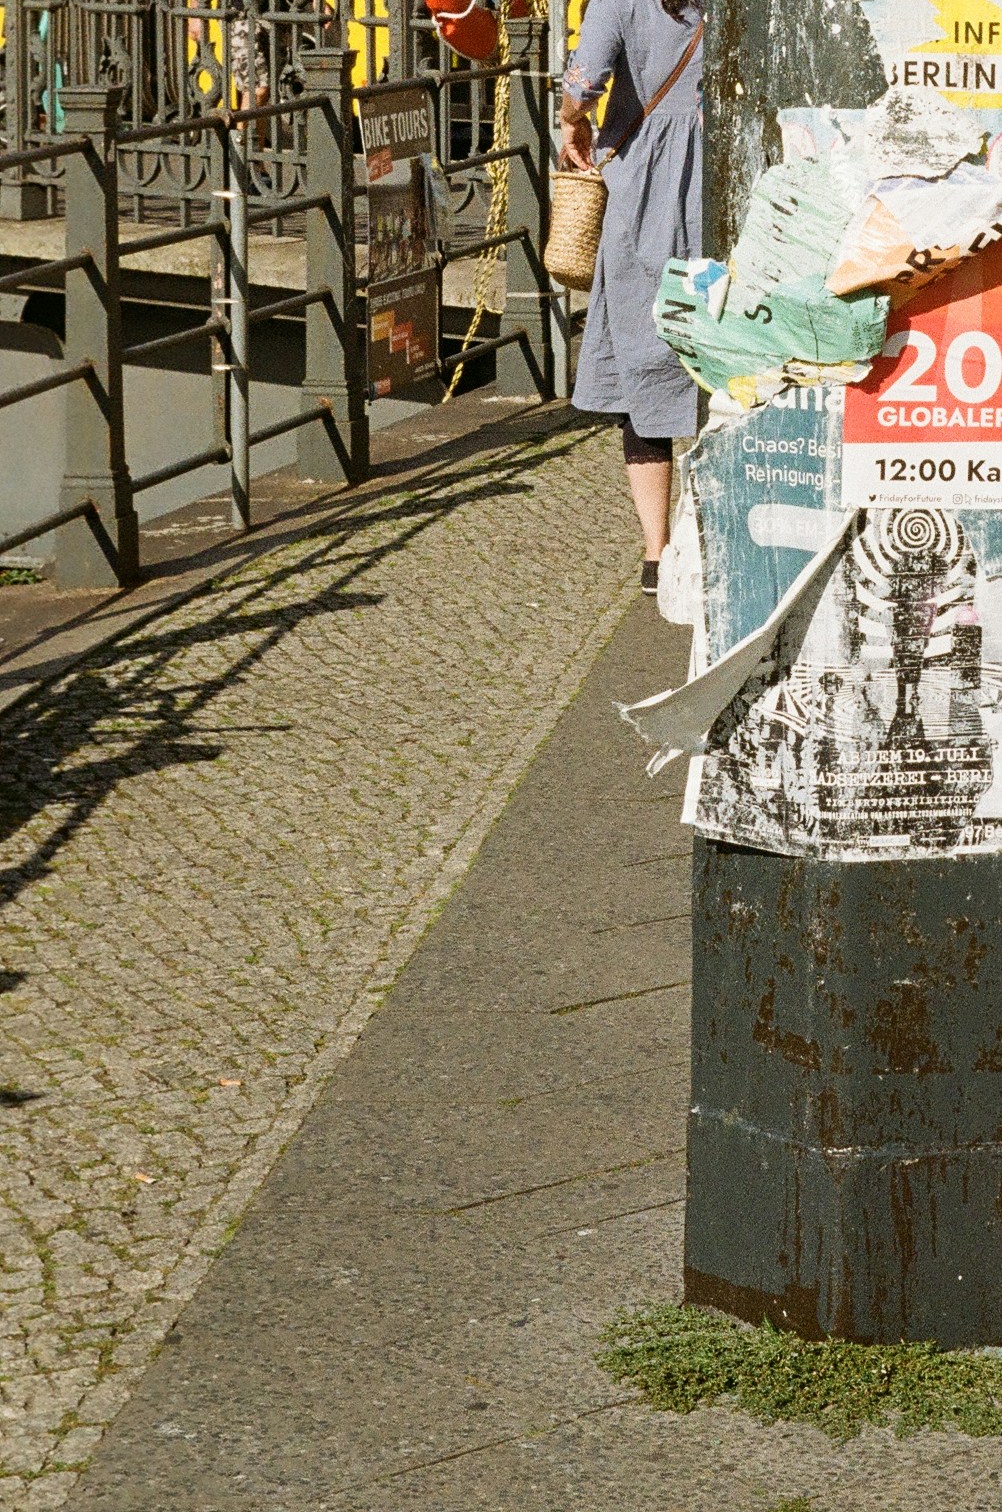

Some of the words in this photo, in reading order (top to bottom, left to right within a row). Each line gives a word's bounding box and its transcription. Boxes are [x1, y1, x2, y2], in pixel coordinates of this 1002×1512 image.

[364, 115, 391, 149] BIKE
[390, 108, 429, 143] TOURS
[742, 435, 805, 455] Chaos?
[875, 458, 956, 483] 12:00
[865, 749, 903, 765] DEM
[932, 746, 979, 763] JULI
